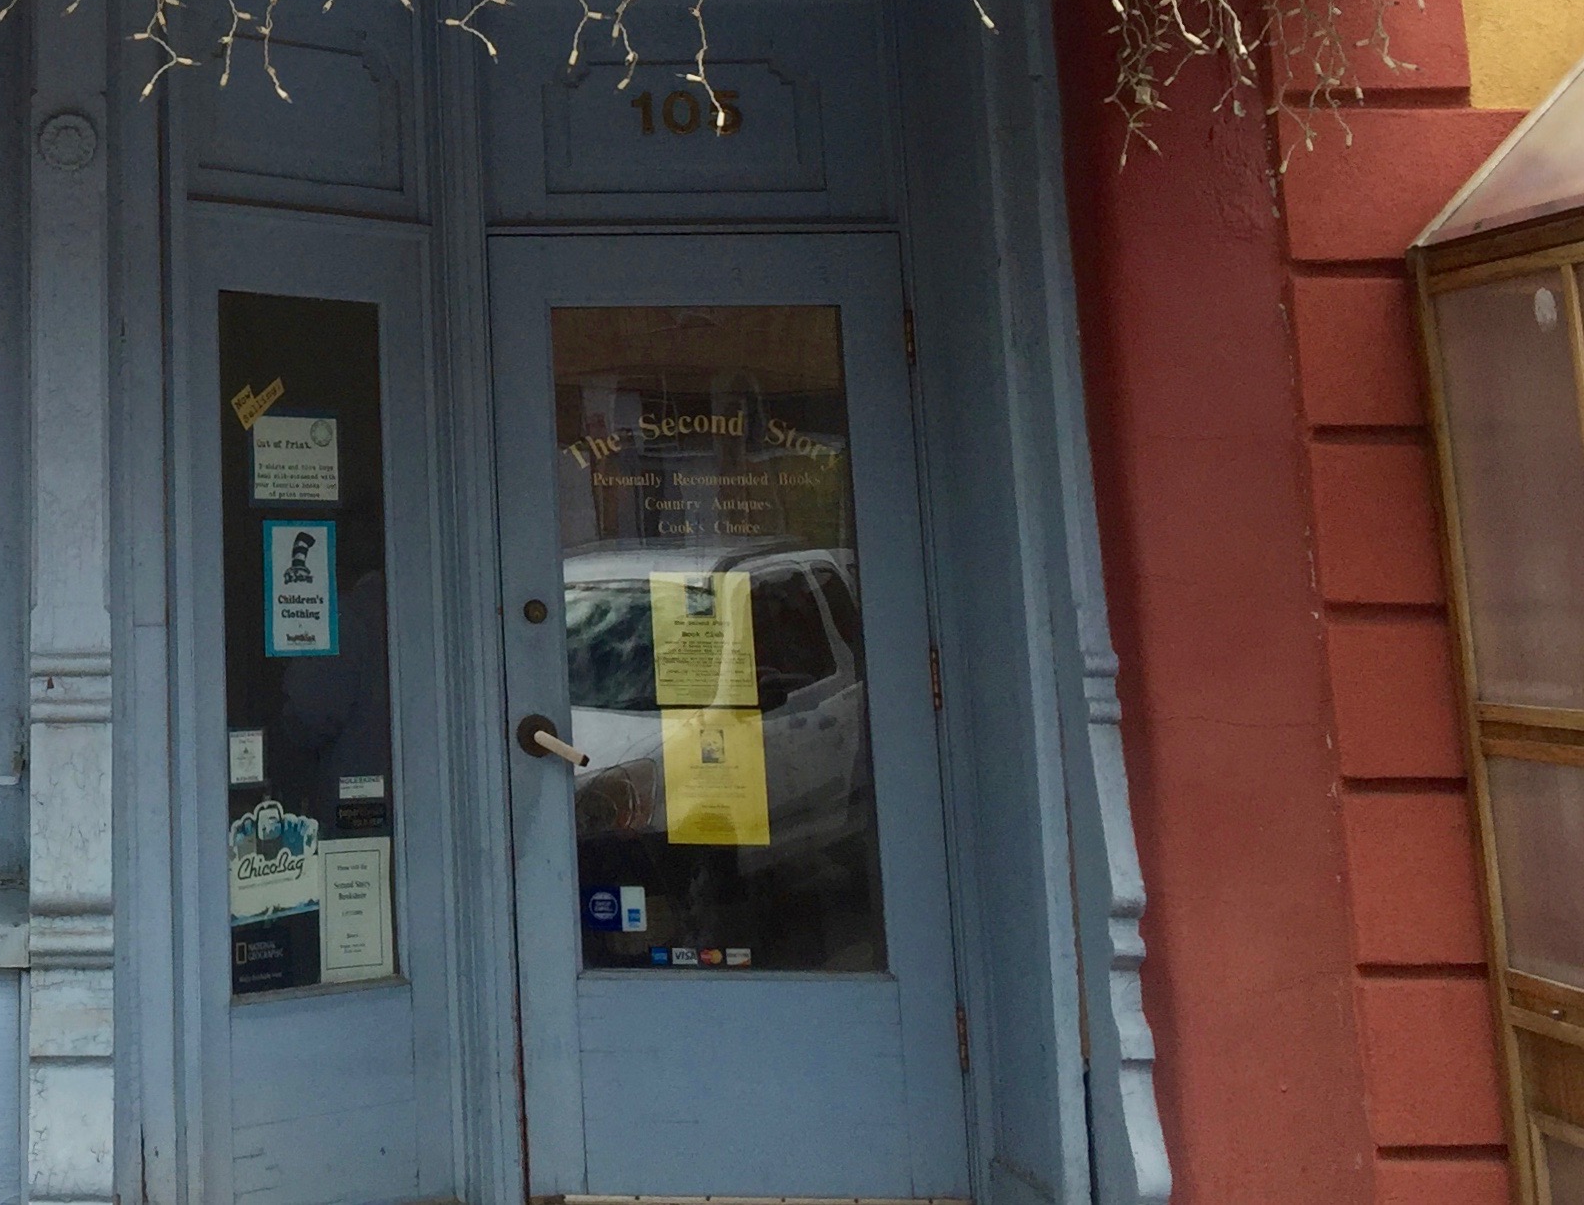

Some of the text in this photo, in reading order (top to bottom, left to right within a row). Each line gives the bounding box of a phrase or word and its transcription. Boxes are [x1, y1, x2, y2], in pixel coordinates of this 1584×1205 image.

[630, 90, 744, 136] 105
[563, 409, 843, 471] The Second Story
[593, 472, 821, 488] Personally Recommended Books
[645, 496, 772, 511] Country Antiques
[713, 520, 763, 535] Choice
[278, 594, 324, 605] Children's
[280, 608, 321, 621] Clothing
[237, 850, 306, 881] ChicoBag
[675, 951, 696, 960] VISA
